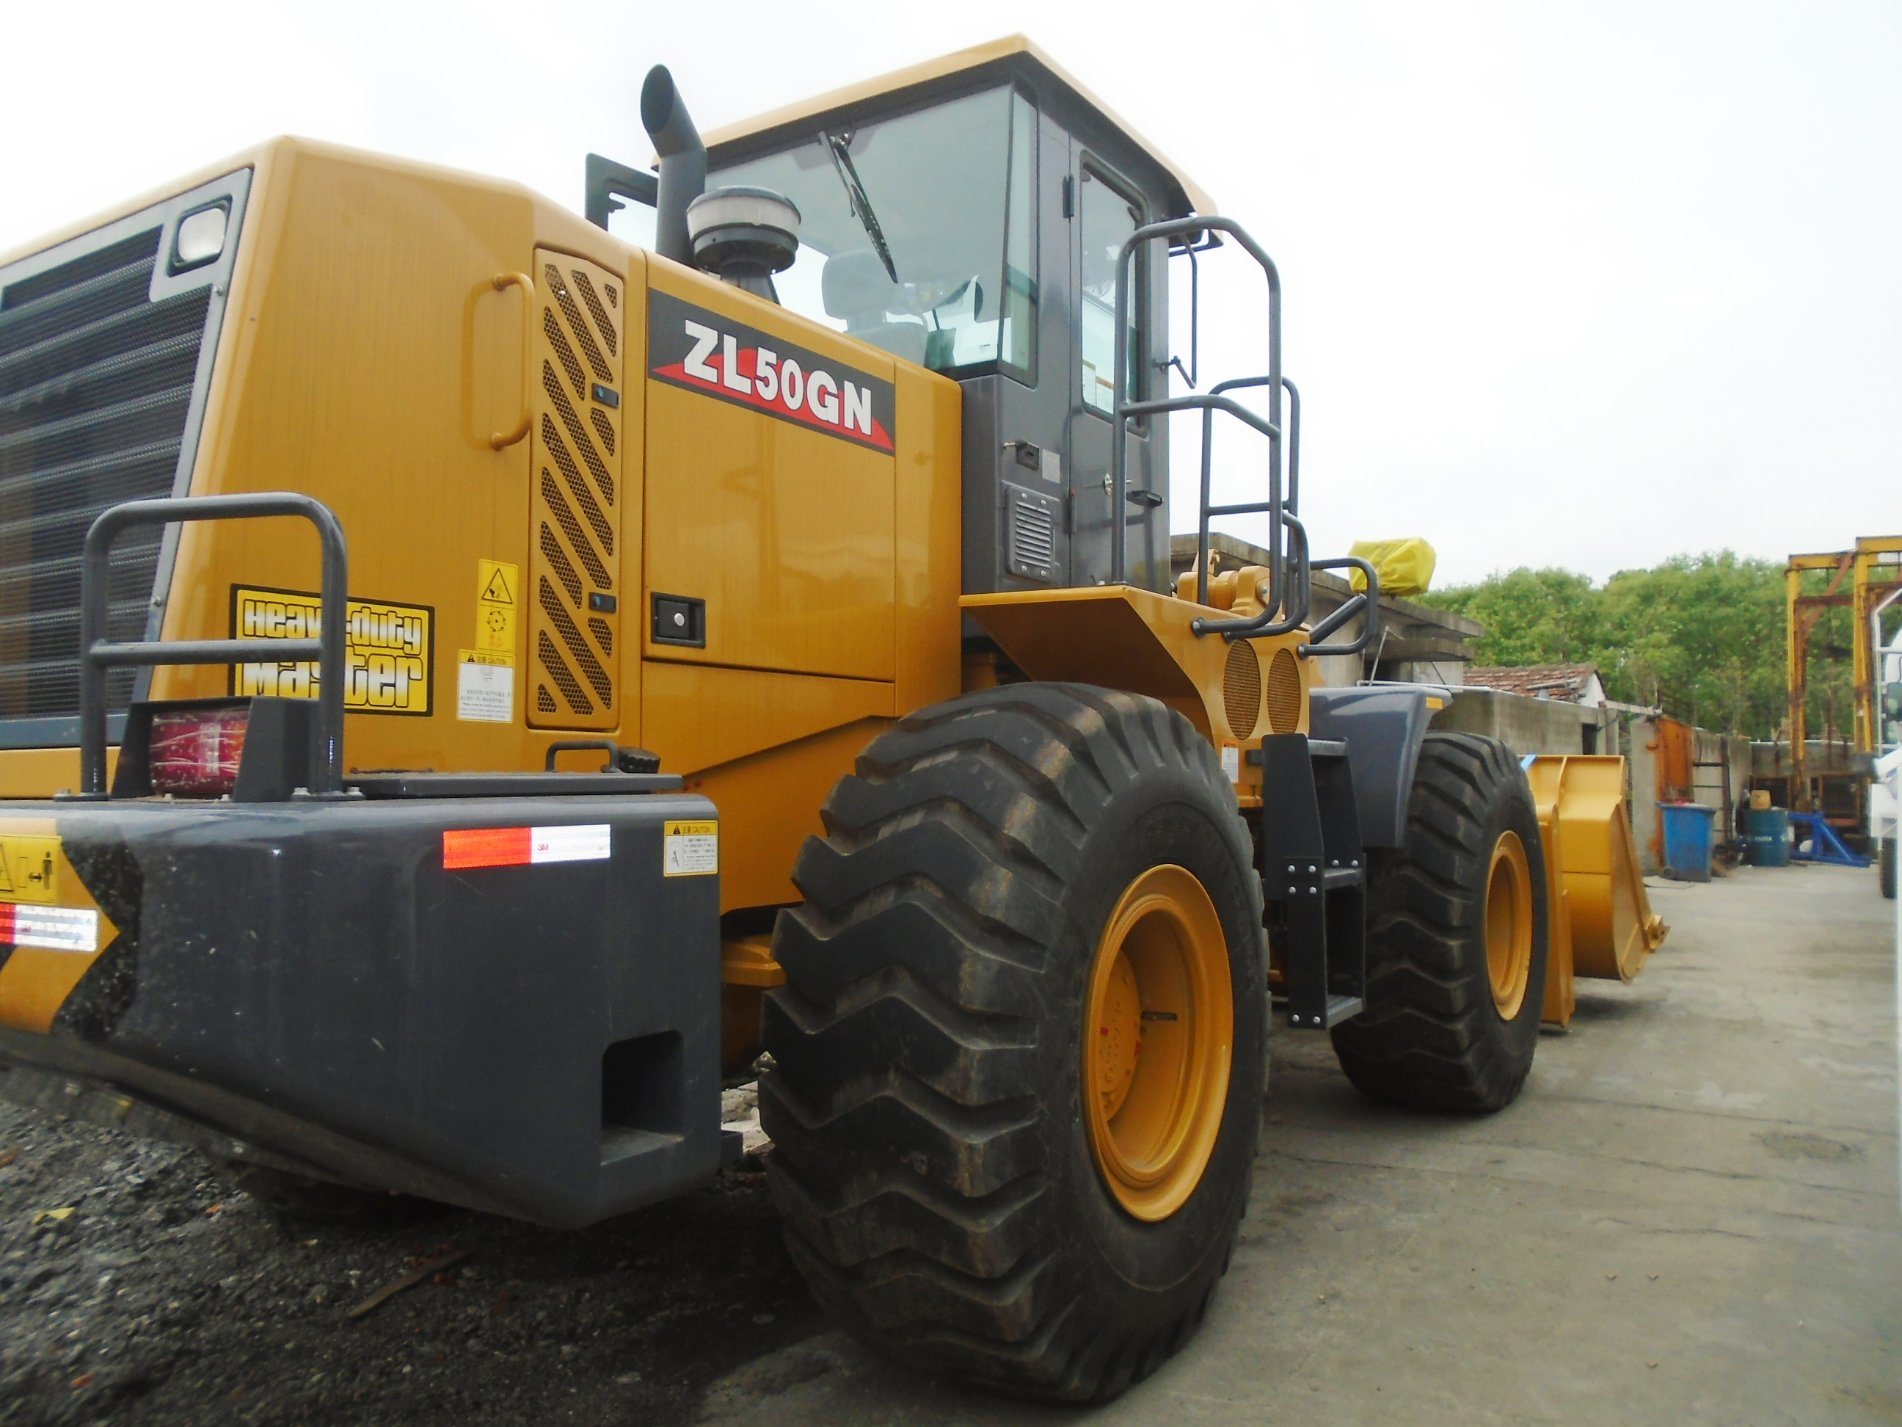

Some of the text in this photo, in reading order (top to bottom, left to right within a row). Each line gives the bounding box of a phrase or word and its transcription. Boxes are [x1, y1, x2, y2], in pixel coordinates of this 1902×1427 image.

[683, 319, 872, 436] ZL50GN
[243, 598, 422, 656] Heav-duty
[537, 843, 549, 852] 3M
